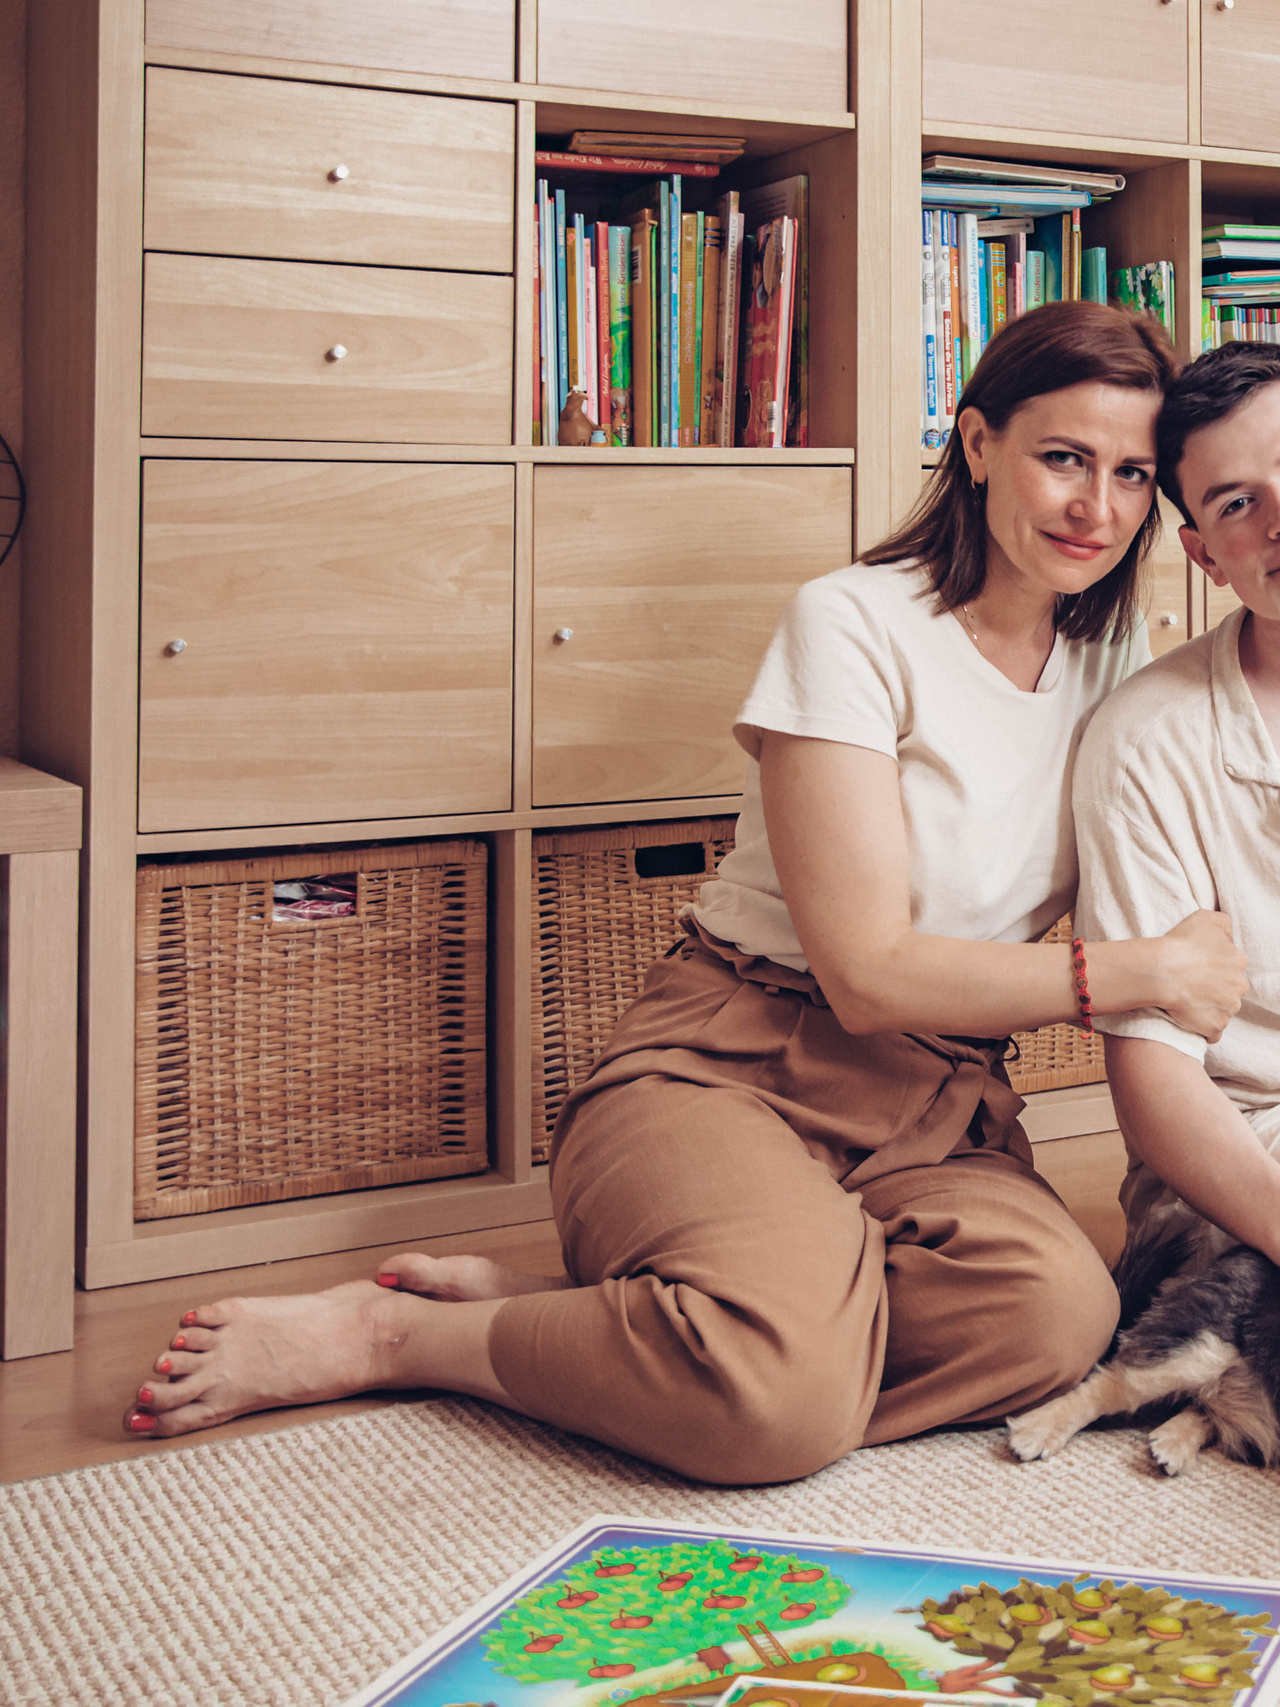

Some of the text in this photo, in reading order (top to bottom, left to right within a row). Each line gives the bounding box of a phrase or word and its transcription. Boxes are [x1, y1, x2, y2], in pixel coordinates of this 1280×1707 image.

[564, 154, 587, 163] Kinder
[969, 228, 977, 276] Jahreszeiten
[617, 234, 626, 323] Herders Kinderbibel
[924, 273, 934, 297] tiptoi
[942, 274, 950, 297] tiptoi
[995, 272, 1004, 325] ierbuch
[970, 317, 978, 337] Conni
[927, 380, 935, 408] Englisch
